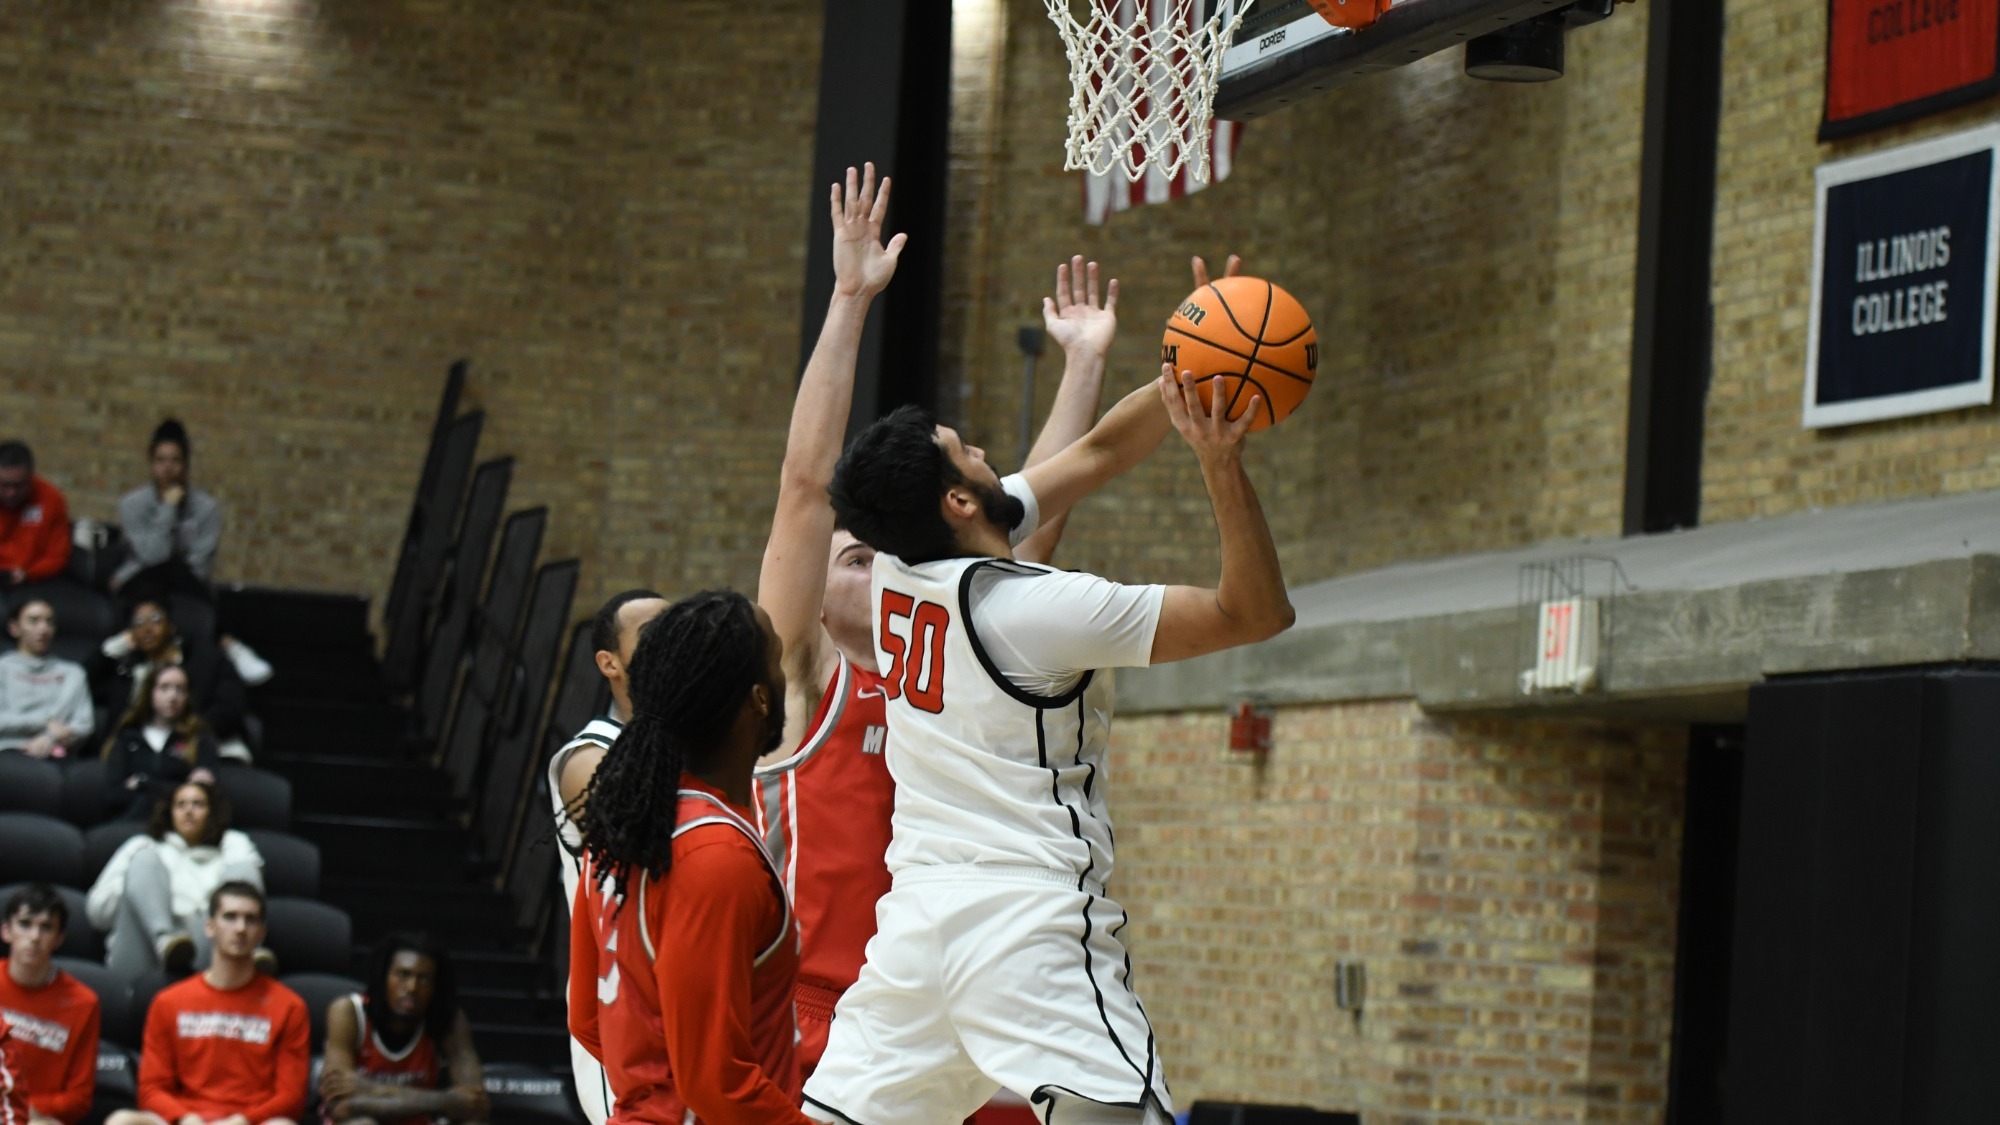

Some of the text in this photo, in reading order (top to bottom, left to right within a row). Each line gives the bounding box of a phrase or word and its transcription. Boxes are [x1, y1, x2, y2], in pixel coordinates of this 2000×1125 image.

[1856, 225, 1951, 282] ILLINOIS
[1852, 280, 1949, 336] COLLEGE
[880, 587, 950, 715] 50
